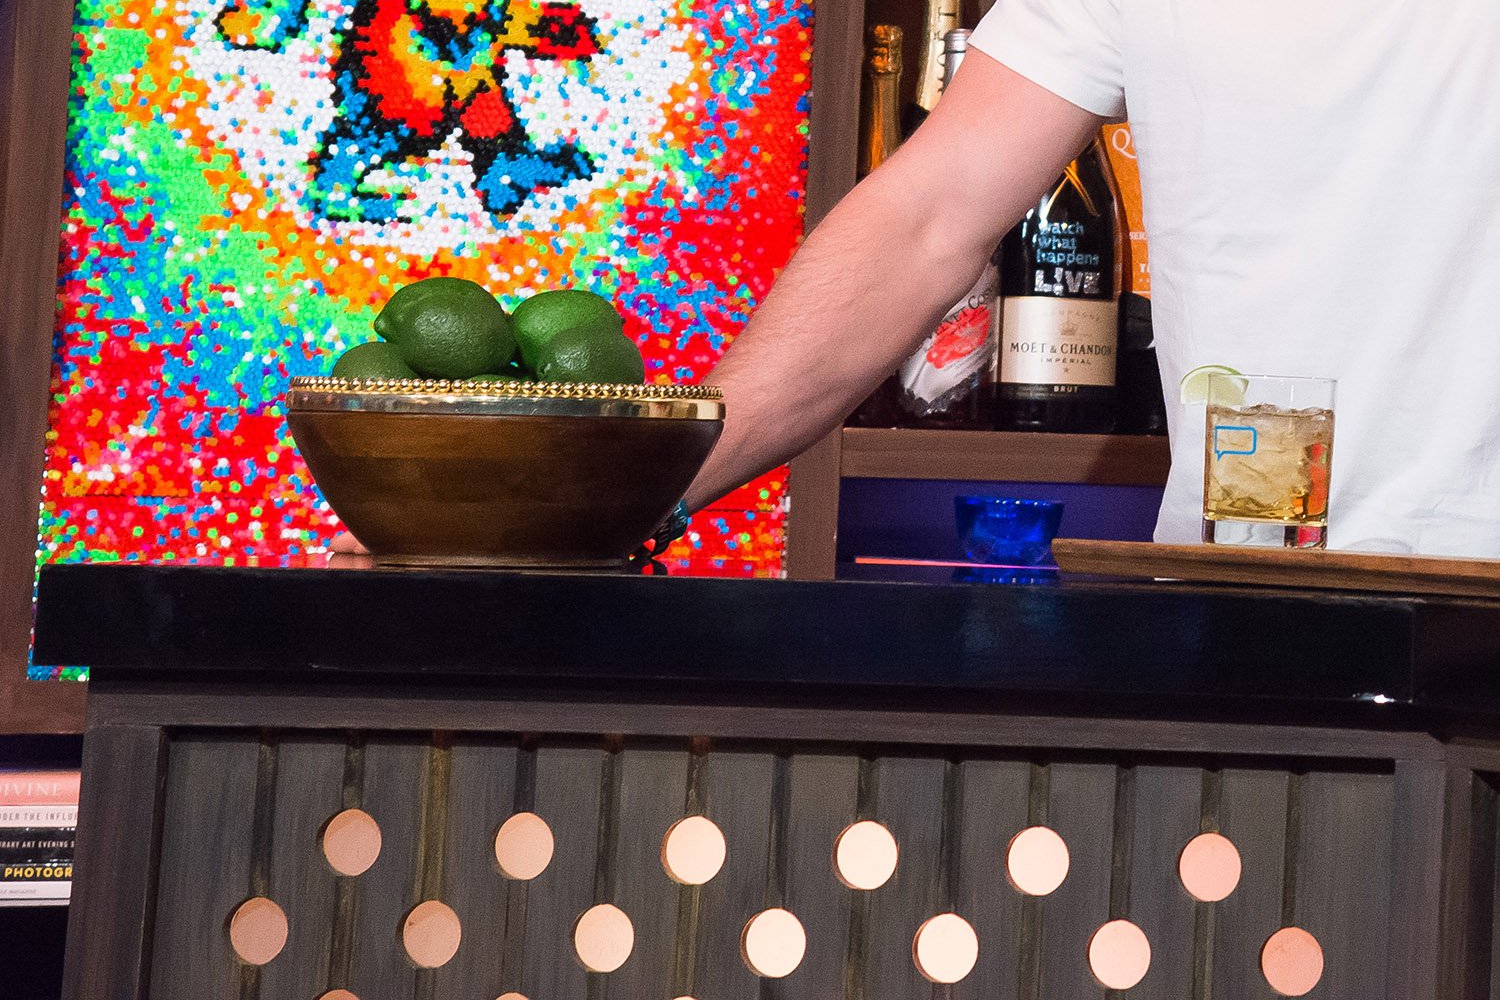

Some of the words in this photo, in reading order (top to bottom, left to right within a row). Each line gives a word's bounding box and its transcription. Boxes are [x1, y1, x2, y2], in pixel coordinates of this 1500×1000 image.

[1111, 128, 1138, 159] Q
[1037, 235, 1077, 250] what
[1036, 248, 1100, 266] happens
[1050, 345, 1058, 354] &
[1060, 342, 1113, 356] CHANDON
[1053, 385, 1080, 394] BRUT
[0, 782, 59, 797] IVINE
[0, 812, 20, 821] DER
[24, 812, 41, 821] THE
[4, 866, 73, 879] PHOTOGR
